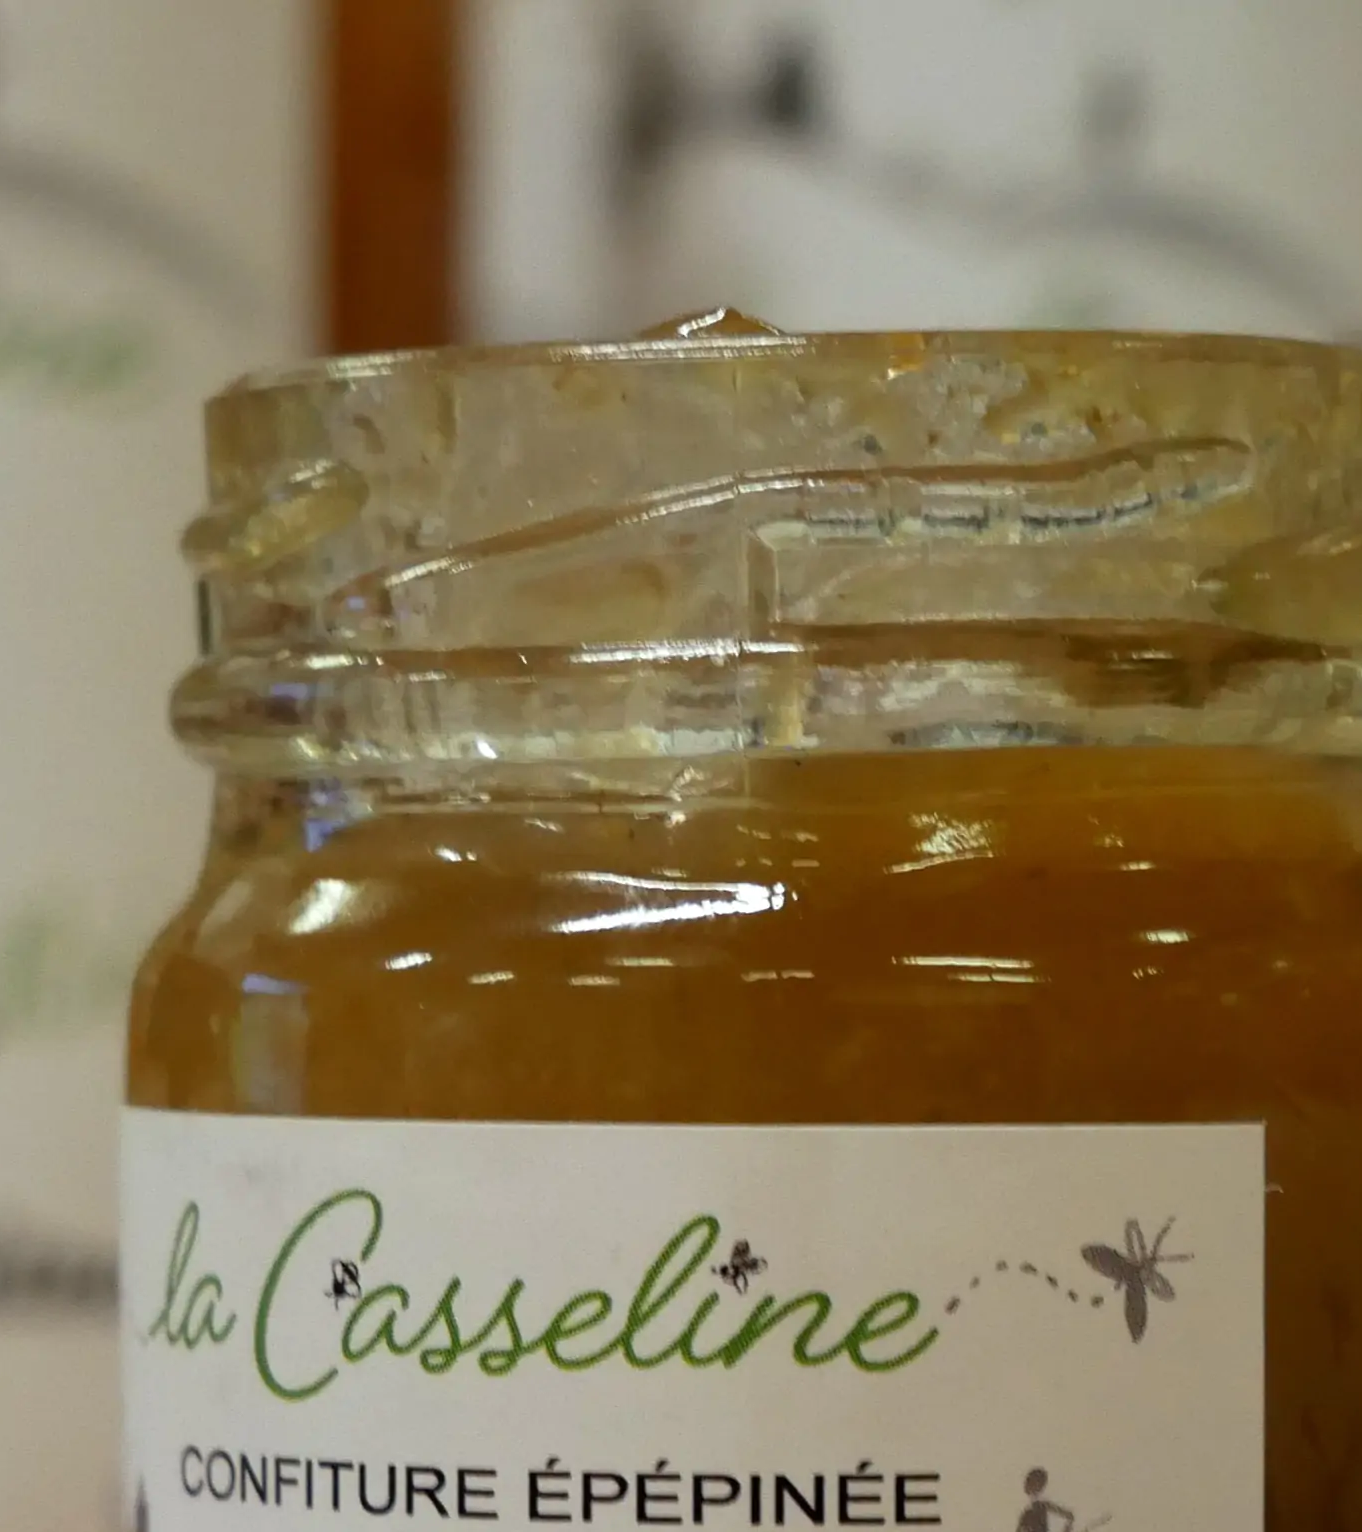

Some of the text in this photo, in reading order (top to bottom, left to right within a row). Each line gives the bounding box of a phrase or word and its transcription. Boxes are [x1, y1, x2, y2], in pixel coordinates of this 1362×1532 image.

[149, 1201, 236, 1350] la
[254, 1189, 938, 1402] Casseline
[180, 1446, 942, 1526] CONFITURE ÉPÉPINÉE
